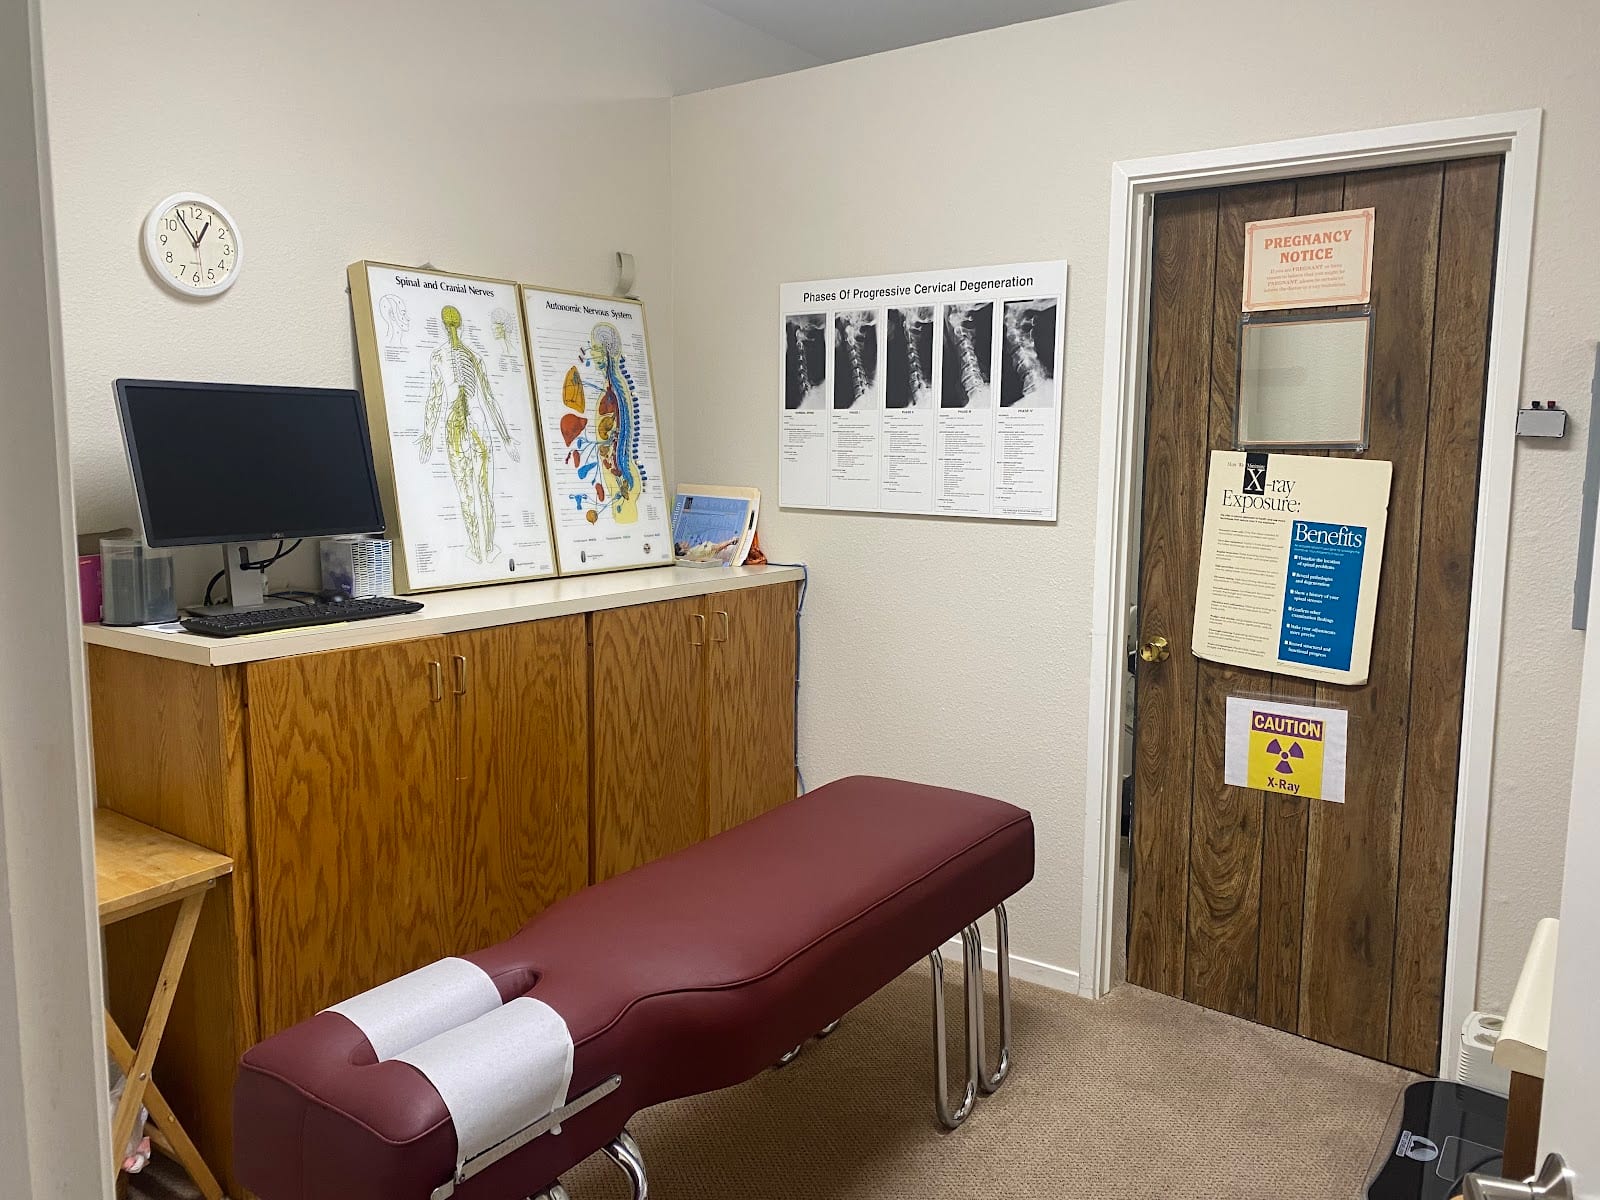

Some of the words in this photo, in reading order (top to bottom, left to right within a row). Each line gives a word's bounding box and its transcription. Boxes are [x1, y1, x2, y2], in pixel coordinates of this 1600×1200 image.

[189, 206, 203, 220] 12
[164, 218, 178, 232] 10
[208, 215, 212, 226] 1
[160, 234, 168, 246] 9
[218, 228, 225, 240] 2
[1264, 229, 1352, 250] PREGNANCY
[165, 251, 173, 263] 8
[223, 244, 230, 256] 3
[1280, 247, 1334, 264] NOTICE
[180, 264, 186, 276] 7
[217, 259, 225, 270] 4
[192, 271, 200, 283] 6
[207, 268, 215, 280] 5
[395, 275, 421, 288] Spinal
[423, 280, 438, 290] and
[440, 281, 467, 294] Cranial
[468, 285, 495, 297] Nerves
[803, 292, 836, 303] Phases
[839, 289, 850, 300] Of
[853, 285, 911, 301] Progressive
[914, 281, 956, 294] Cervical
[960, 276, 1034, 293] Degeneration
[545, 300, 582, 314] Autonomic
[582, 305, 610, 317] Nervous
[610, 309, 633, 320] System
[1244, 468, 1296, 498] X-ray
[1222, 489, 1301, 514] Exposure:
[1294, 522, 1363, 548] Benefits
[1254, 714, 1321, 738] CAUTION
[1267, 776, 1300, 794] X-Ray
